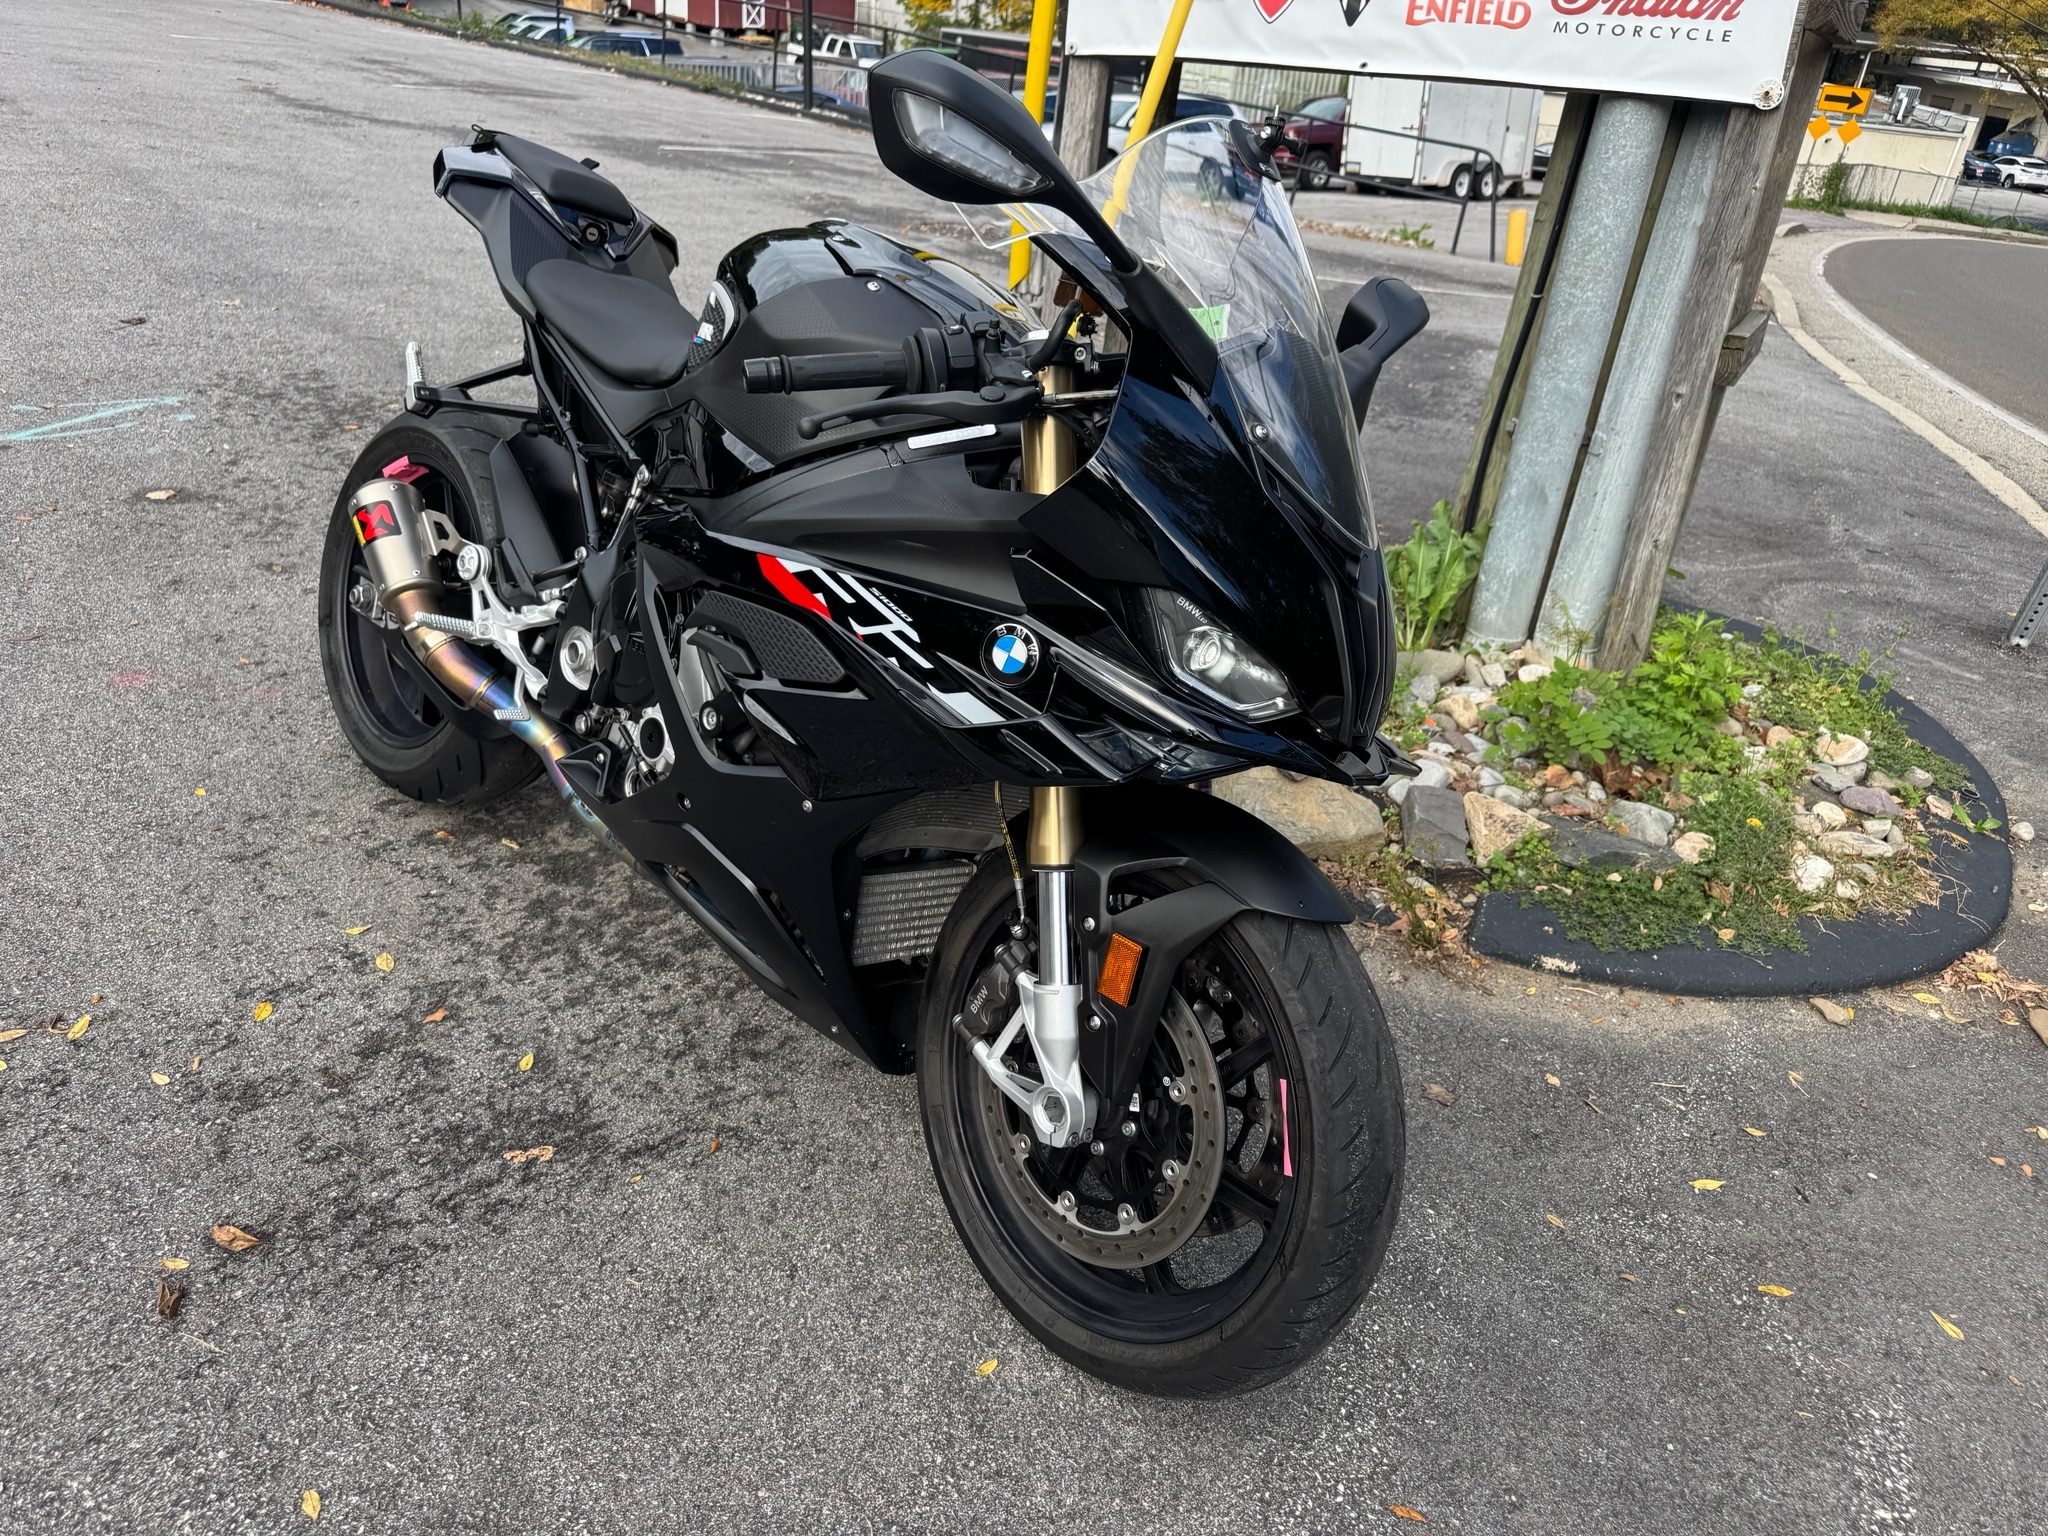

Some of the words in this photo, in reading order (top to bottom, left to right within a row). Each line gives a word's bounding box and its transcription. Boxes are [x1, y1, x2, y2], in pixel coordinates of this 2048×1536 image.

[1405, 0, 1532, 30] ENFIELD
[1553, 21, 1733, 43] MOTORCYCLE
[1176, 596, 1203, 618] BMW
[995, 625, 1039, 667] BMW
[970, 985, 989, 1014] BMW
